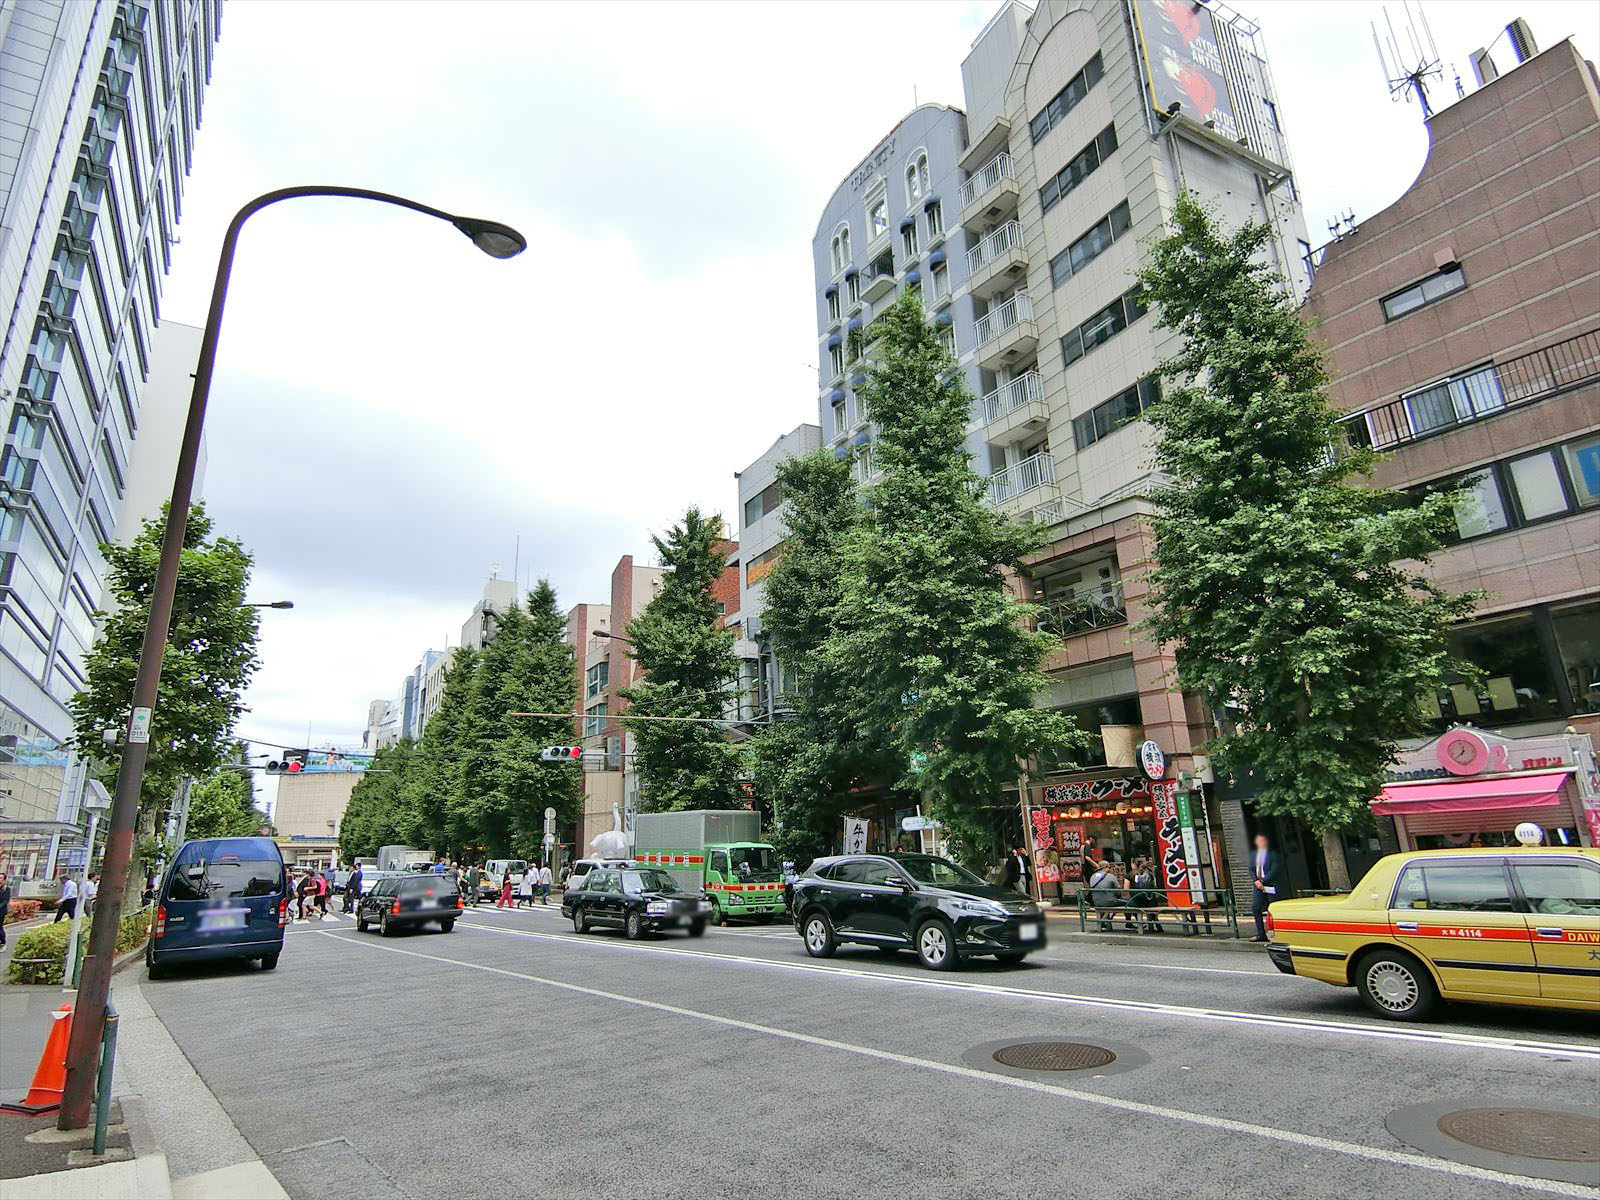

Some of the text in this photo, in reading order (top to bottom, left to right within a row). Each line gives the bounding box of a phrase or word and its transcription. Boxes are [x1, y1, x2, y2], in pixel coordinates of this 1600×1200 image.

[1196, 36, 1220, 57] HYDE
[1212, 108, 1235, 128] HYDE
[851, 138, 896, 192] TRINITY
[1518, 829, 1535, 838] 4114
[1458, 928, 1482, 938] 4114
[1567, 932, 1600, 943] DAIW
[1587, 949, 1600, 961] 大
